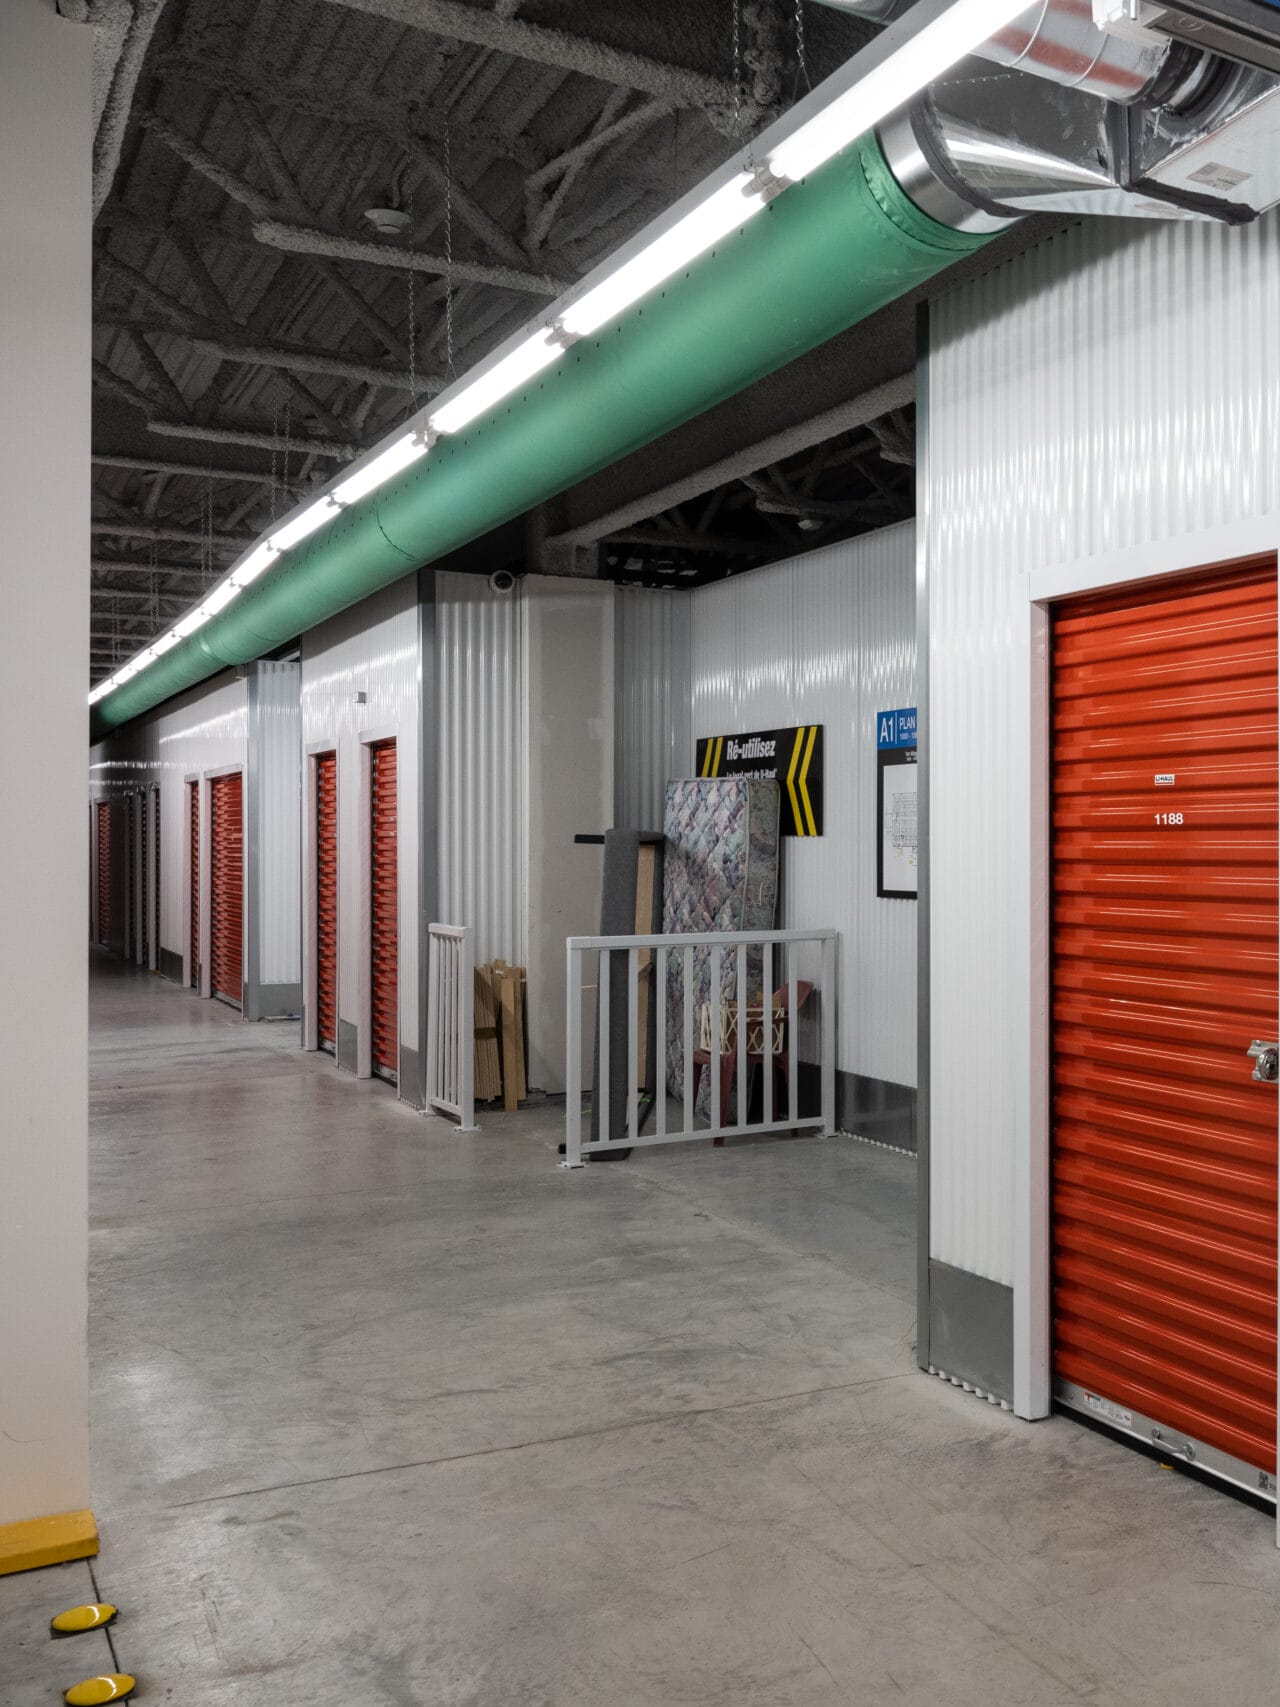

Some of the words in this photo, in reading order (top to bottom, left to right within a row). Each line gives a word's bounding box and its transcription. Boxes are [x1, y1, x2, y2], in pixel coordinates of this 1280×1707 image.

[880, 717, 894, 743] A1
[899, 716, 916, 730] PLAN
[726, 738, 776, 760] Ré-utilisez
[1154, 812, 1184, 825] 1188
